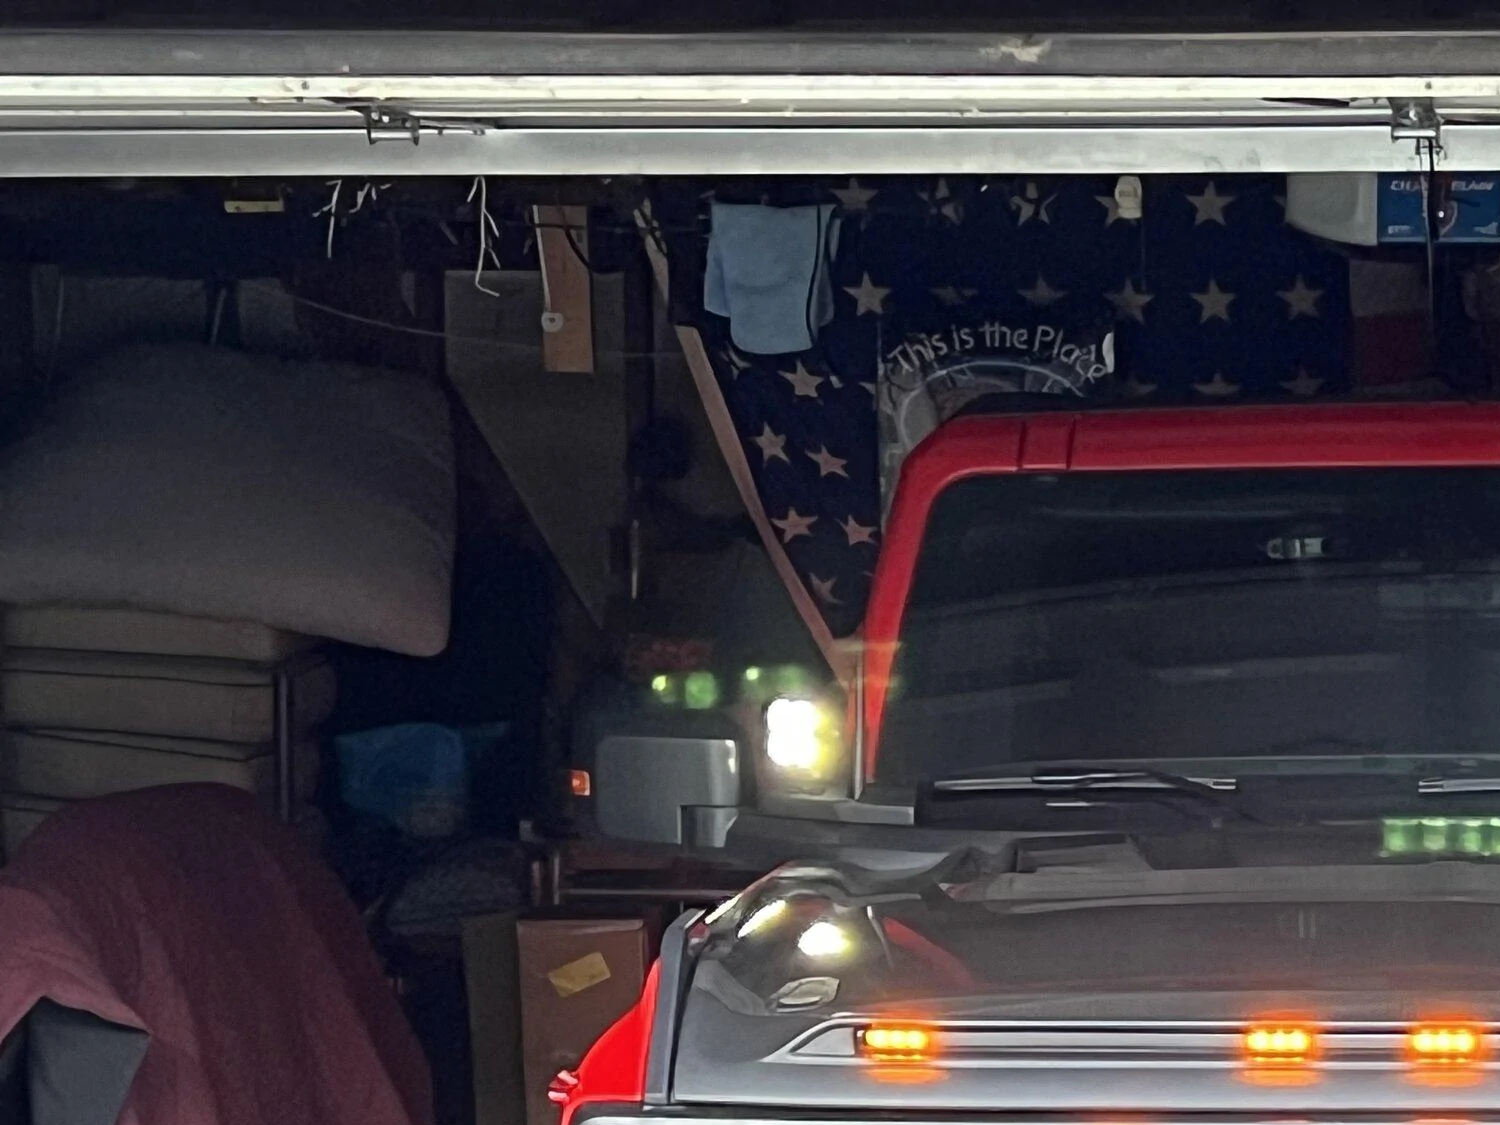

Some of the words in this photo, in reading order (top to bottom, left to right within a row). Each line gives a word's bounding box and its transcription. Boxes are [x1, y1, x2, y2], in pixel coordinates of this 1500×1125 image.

[887, 332, 949, 374] This
[951, 323, 975, 352] is
[978, 320, 1029, 350] the
